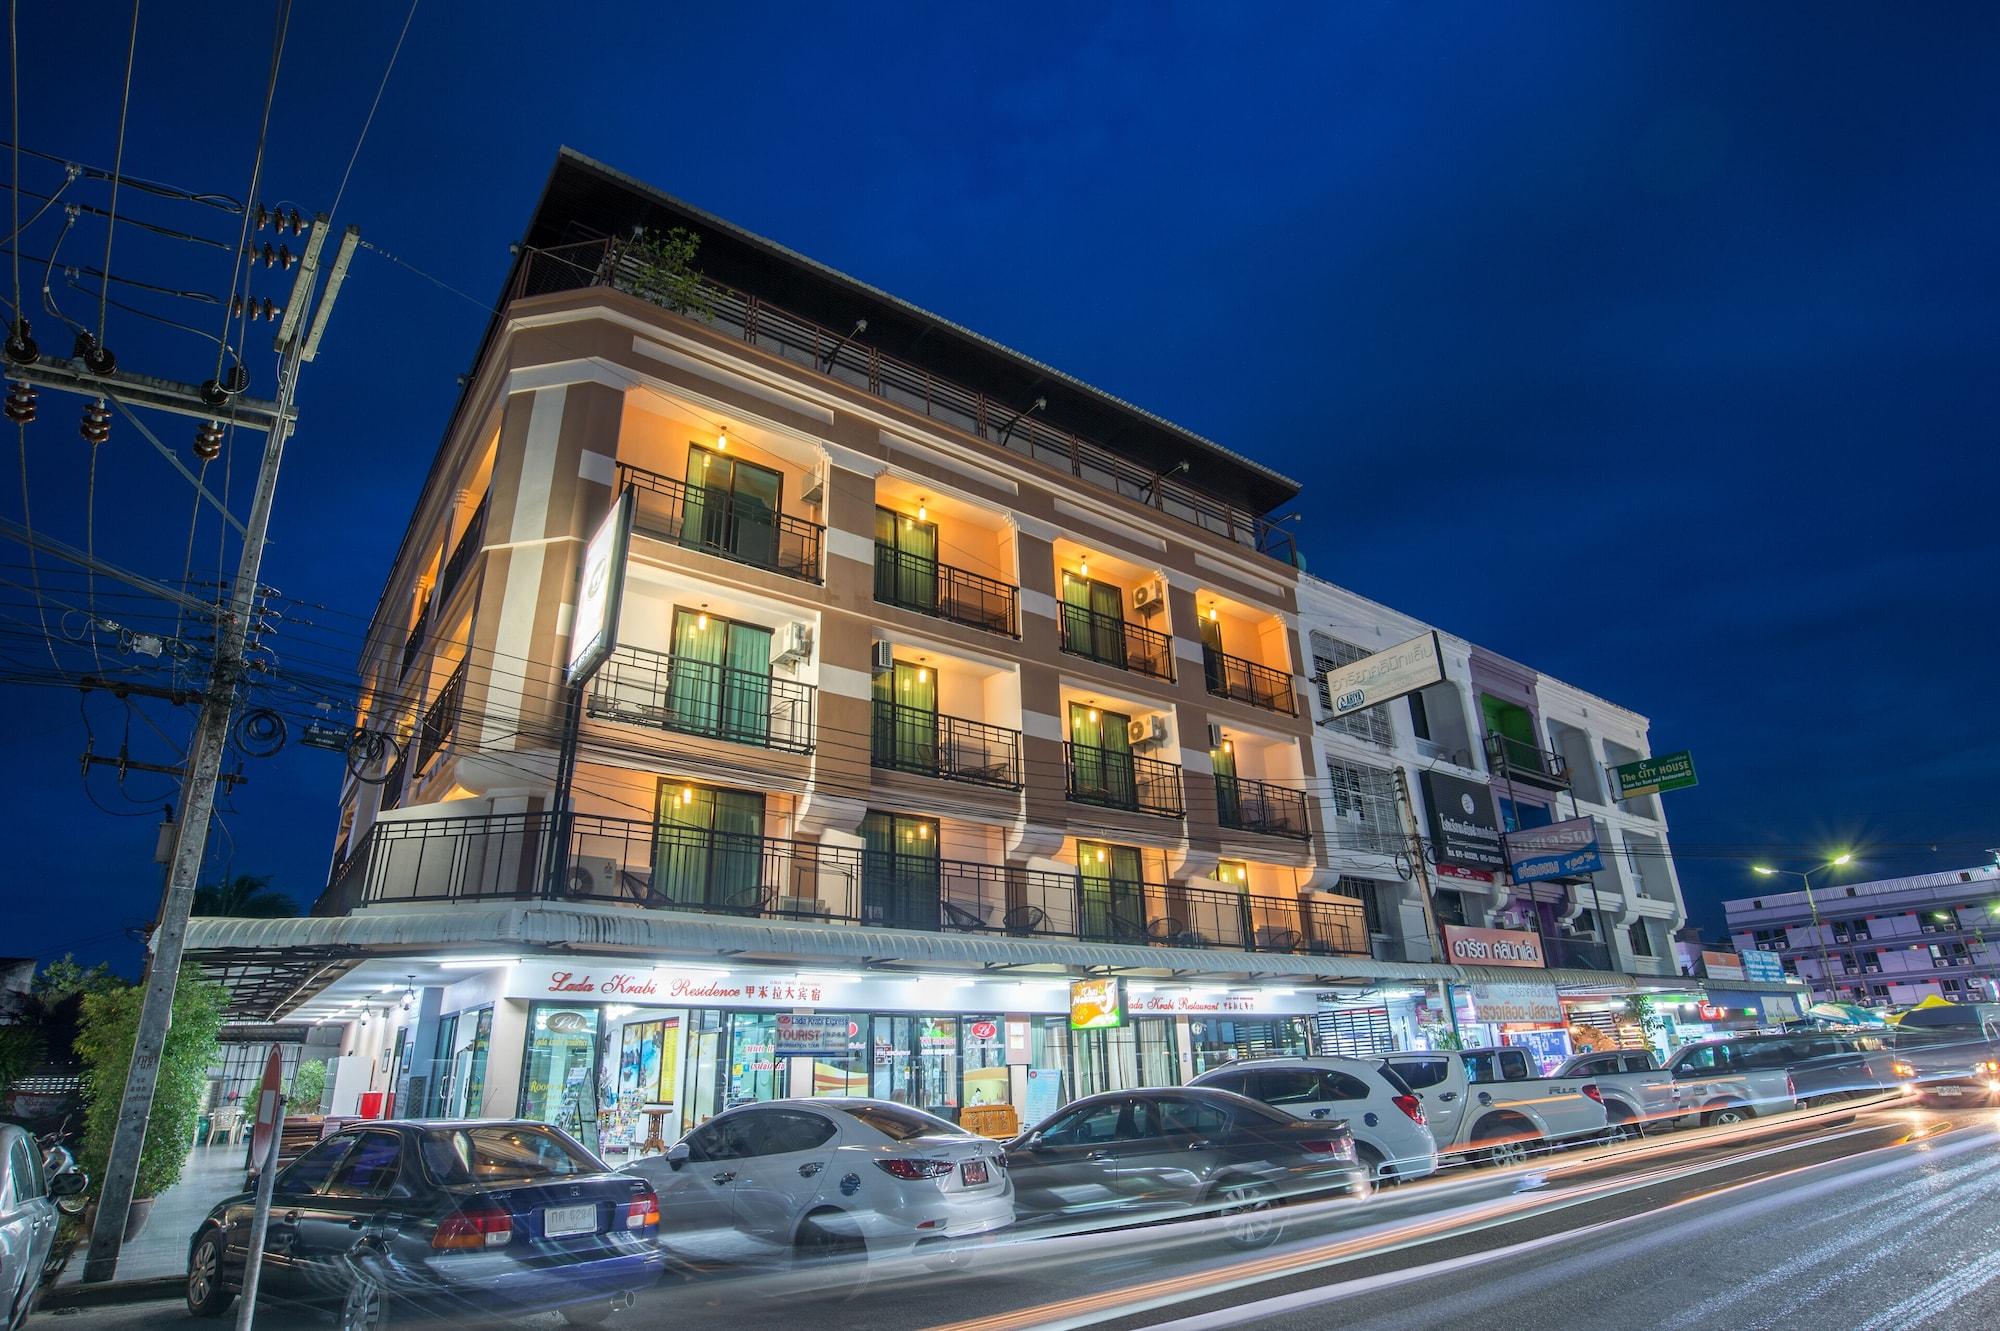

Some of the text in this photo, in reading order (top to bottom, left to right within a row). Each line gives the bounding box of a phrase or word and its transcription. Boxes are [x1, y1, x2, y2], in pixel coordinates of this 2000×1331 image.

[1621, 761, 1689, 782] The CITY HOUSE
[548, 971, 741, 997] Lada Krabi Residence
[1147, 997, 1175, 1010] Krabi
[1178, 997, 1220, 1011] Restaurant
[777, 1029, 821, 1041] TOURIST
